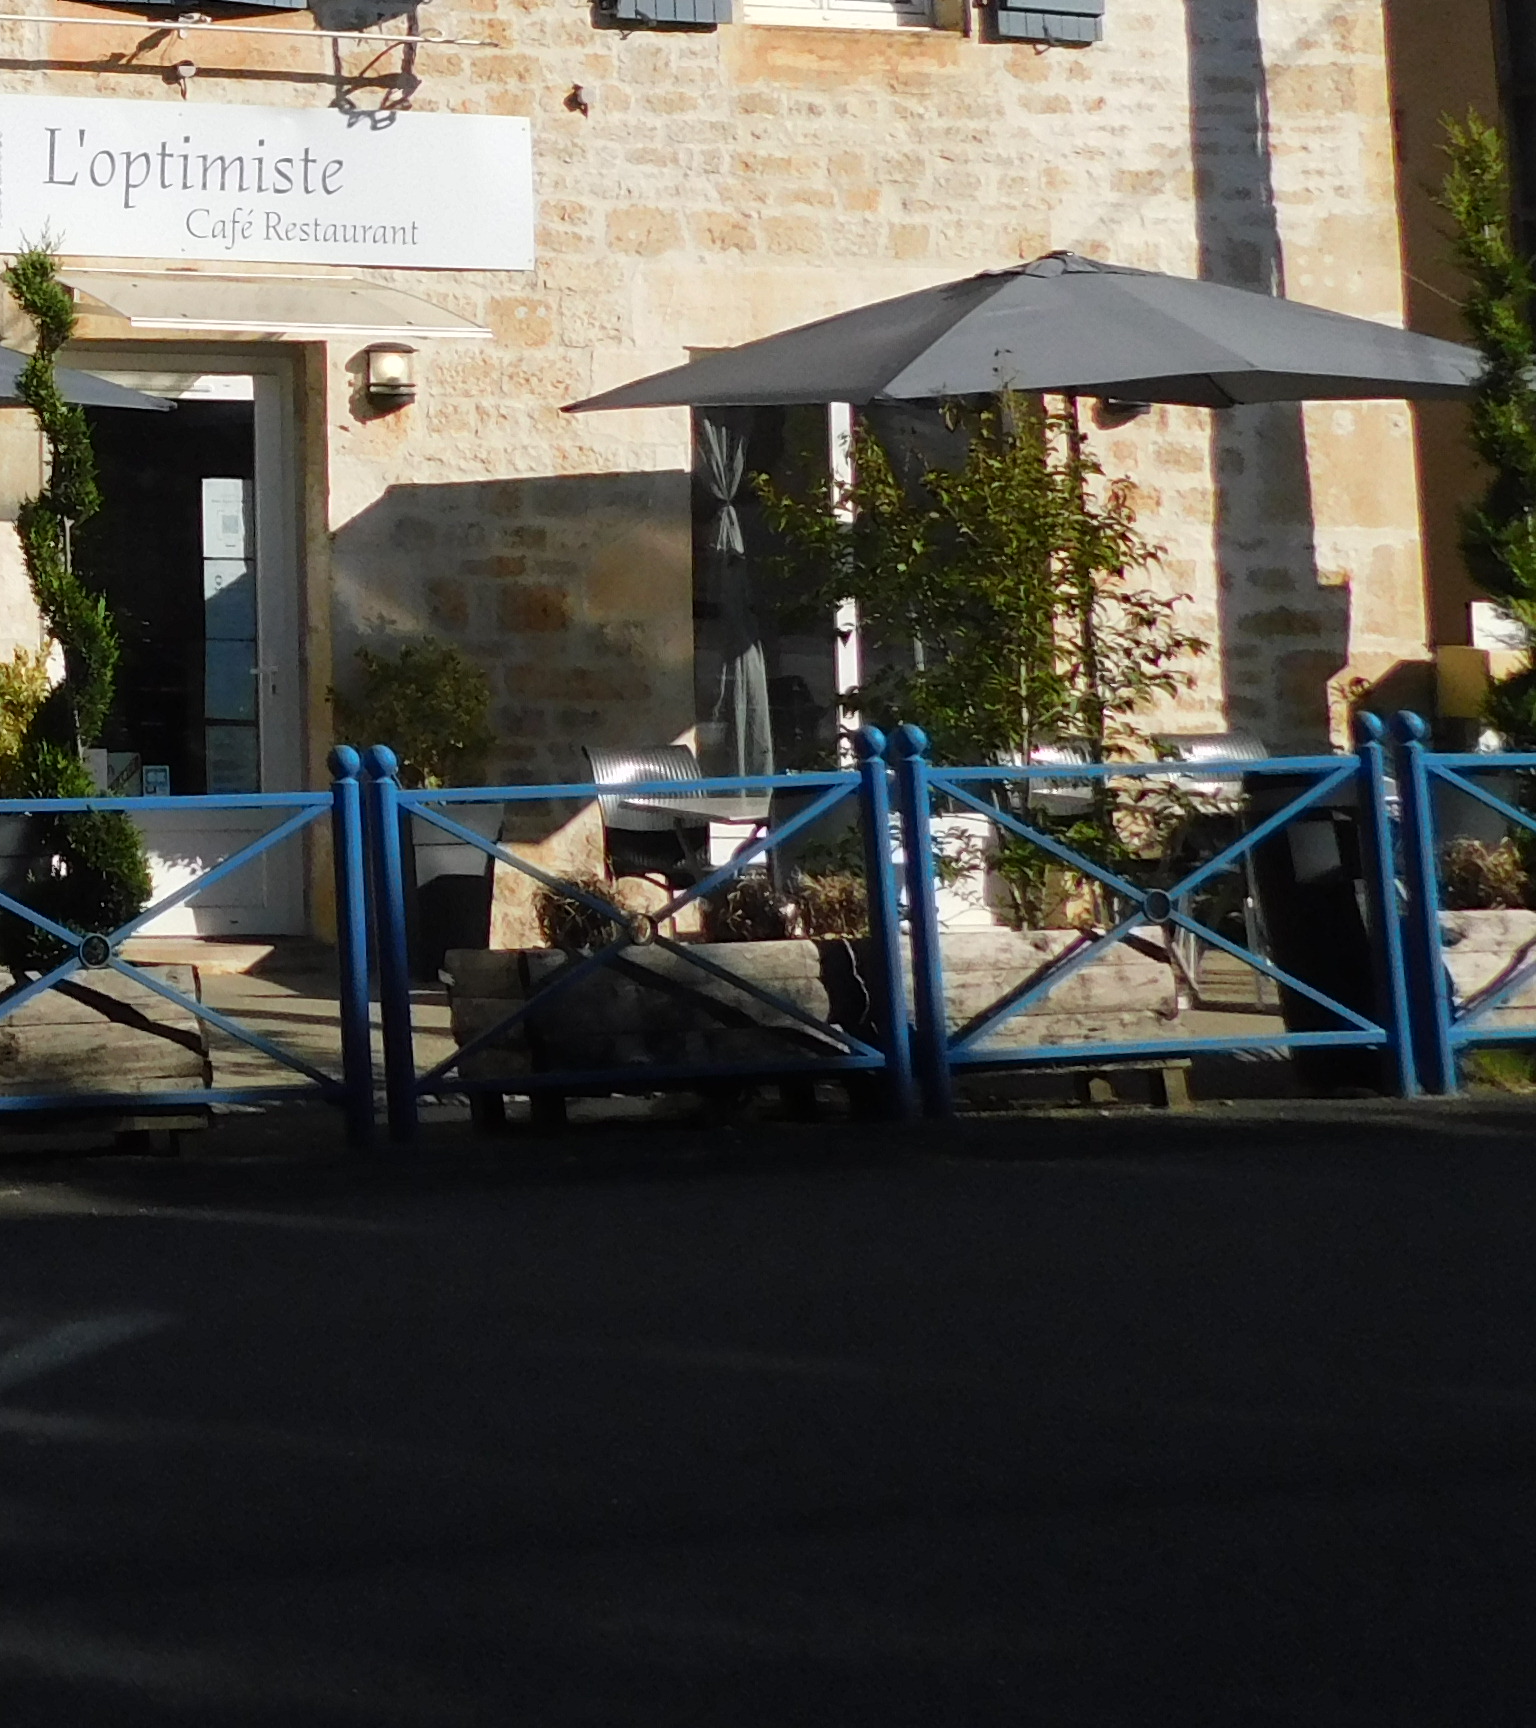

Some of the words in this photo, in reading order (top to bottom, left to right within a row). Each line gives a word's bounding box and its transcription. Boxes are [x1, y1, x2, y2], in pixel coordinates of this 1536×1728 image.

[43, 127, 344, 209] L'optimiste
[185, 207, 254, 250] Café
[263, 210, 419, 246] Restaurant
